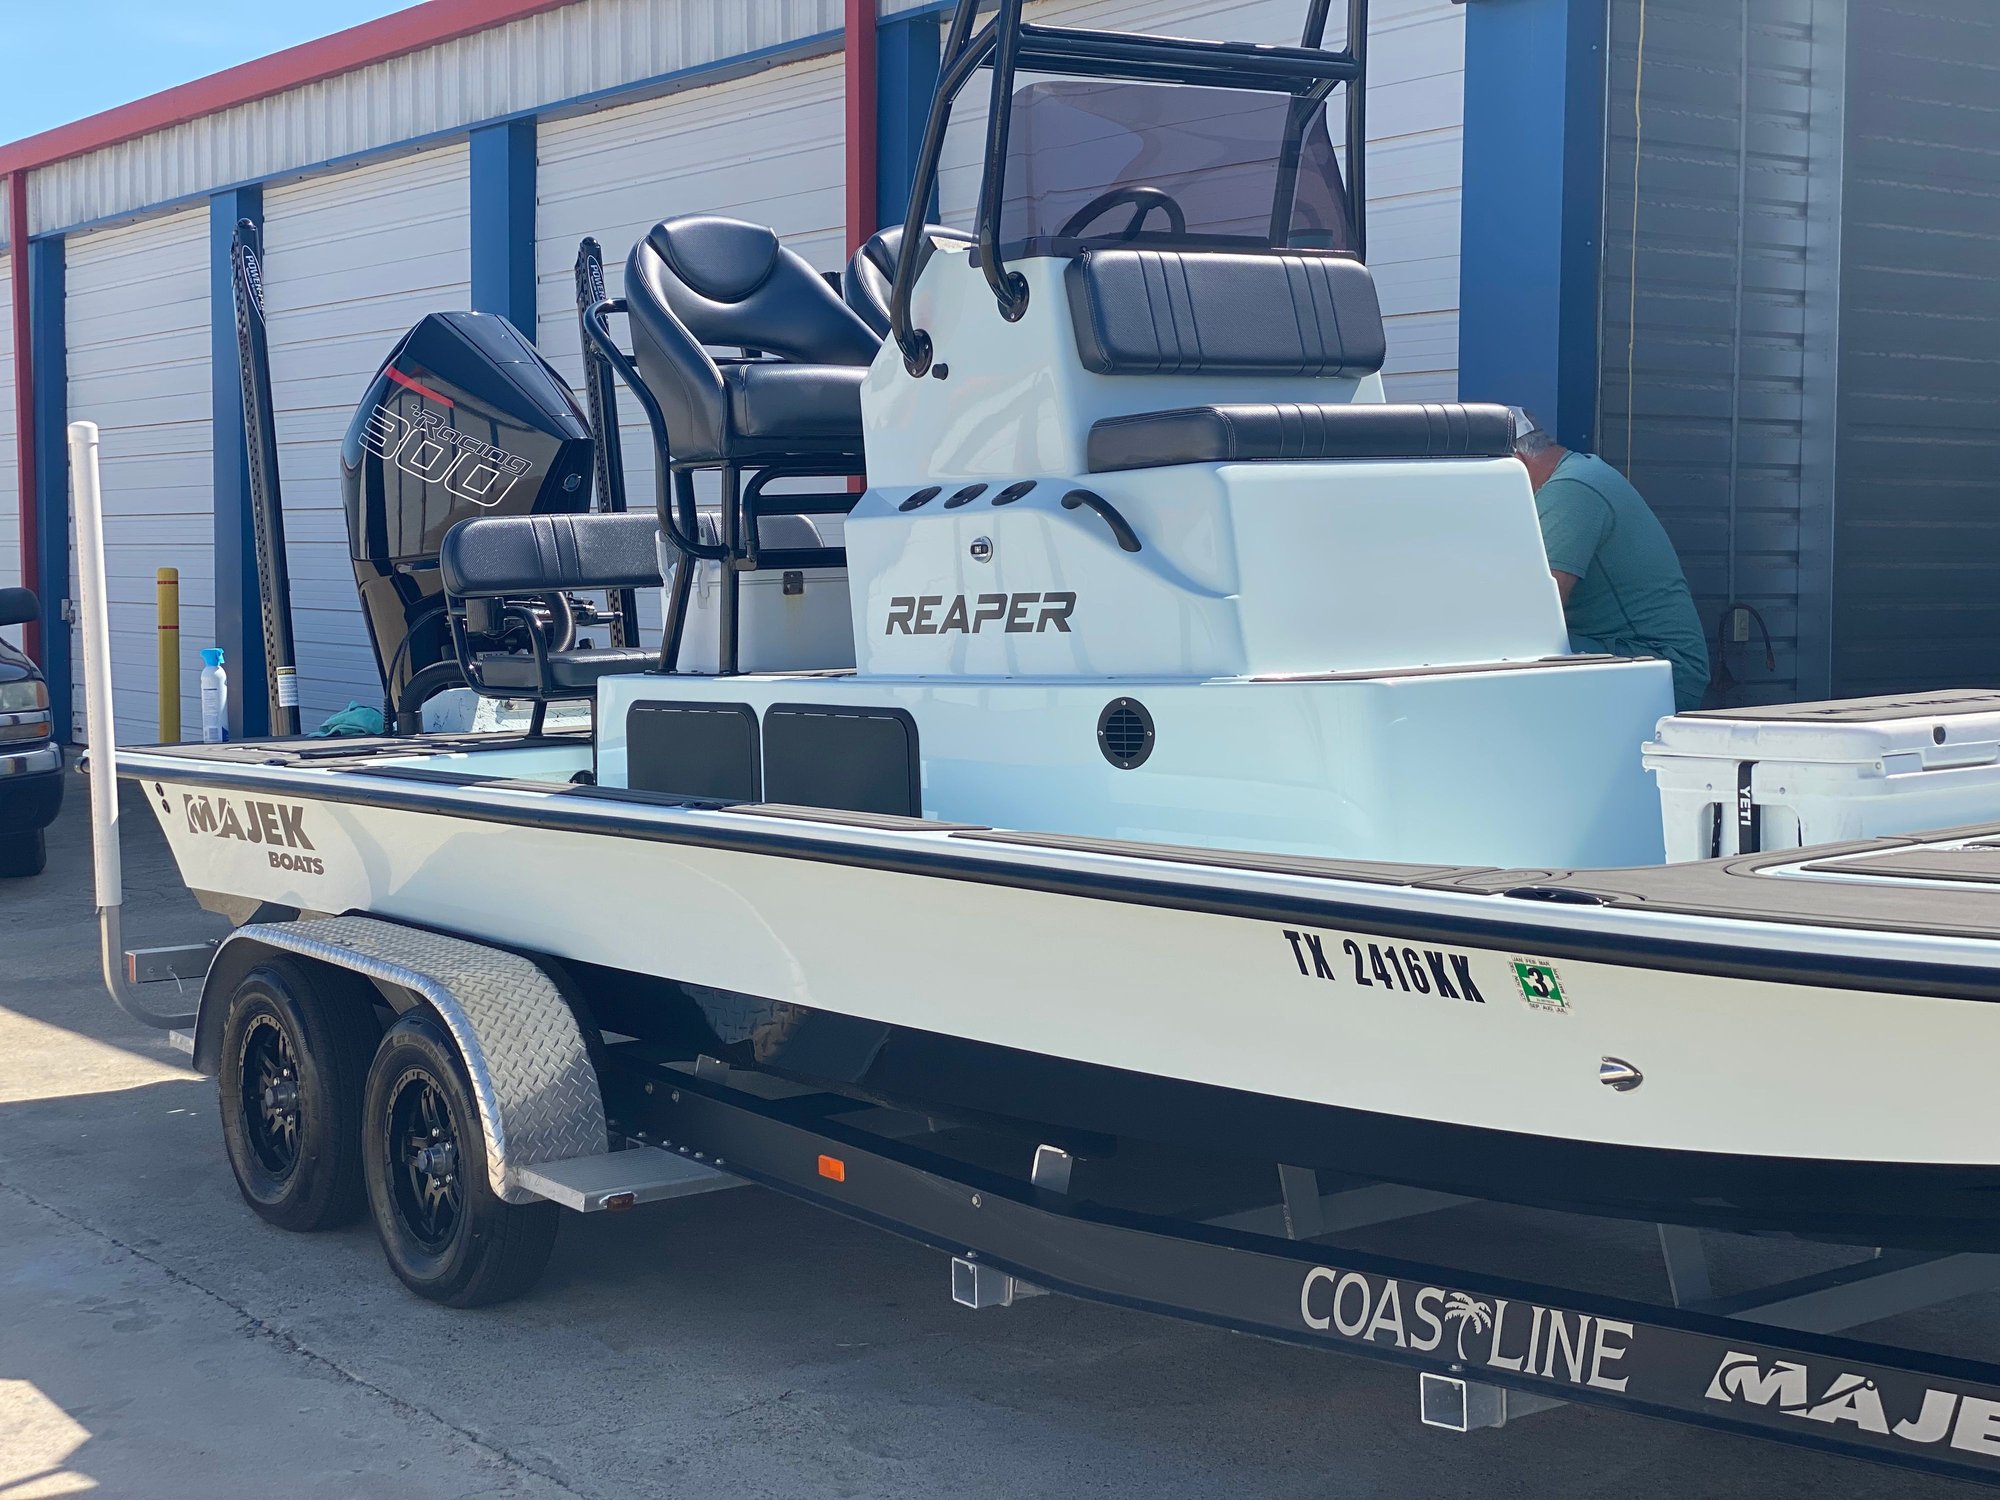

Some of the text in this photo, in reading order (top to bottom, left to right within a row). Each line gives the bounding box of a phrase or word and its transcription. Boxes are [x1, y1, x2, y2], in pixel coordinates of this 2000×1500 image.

[358, 404, 518, 507] 300
[413, 409, 532, 478] Racing
[885, 592, 1077, 635] REAPER
[183, 794, 315, 850] MAJEK
[1740, 786, 1751, 826] YETI
[268, 851, 325, 875] BOATS
[1282, 930, 1486, 1003] TX 2416KK
[1528, 967, 1549, 998] 3
